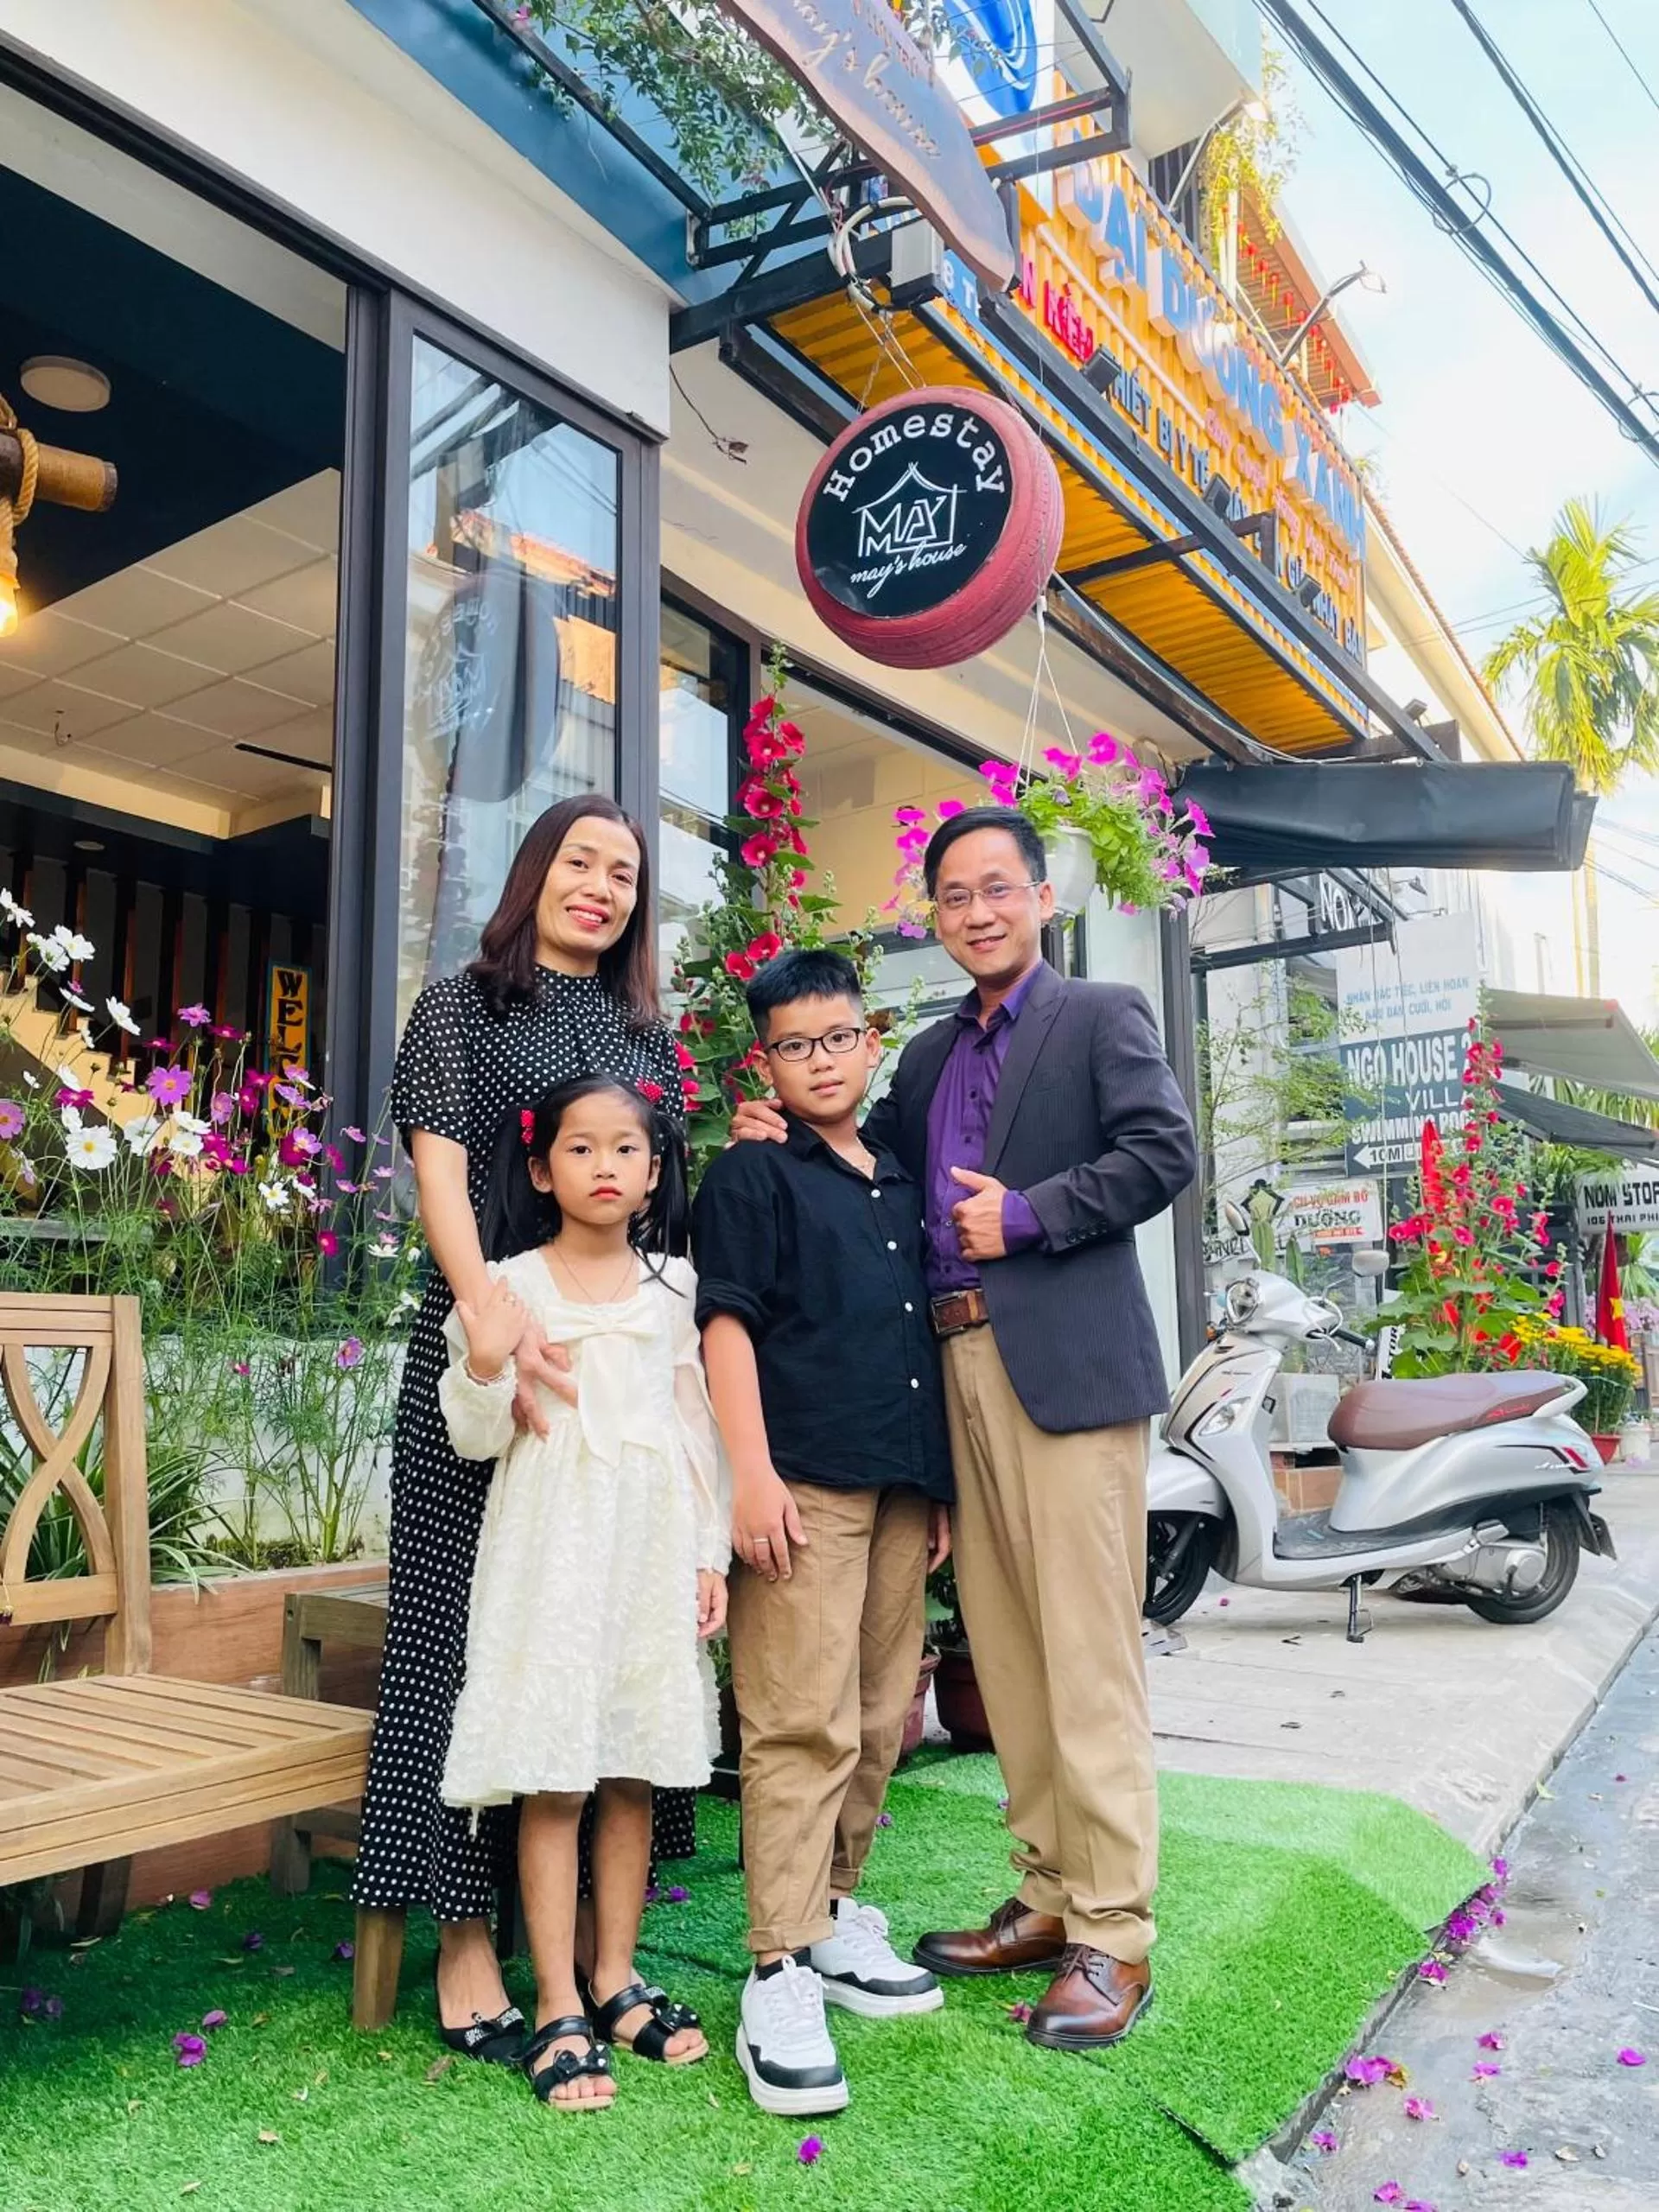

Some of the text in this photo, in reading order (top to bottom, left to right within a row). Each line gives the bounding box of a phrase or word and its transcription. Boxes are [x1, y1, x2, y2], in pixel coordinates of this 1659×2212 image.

[1112, 367, 1152, 434] HIẾT
[823, 412, 1006, 503] Homestay
[1294, 419, 1367, 562] XANH
[857, 494, 948, 558] MAY
[850, 539, 969, 600] may's house
[1390, 1035, 1459, 1086] HOUSE
